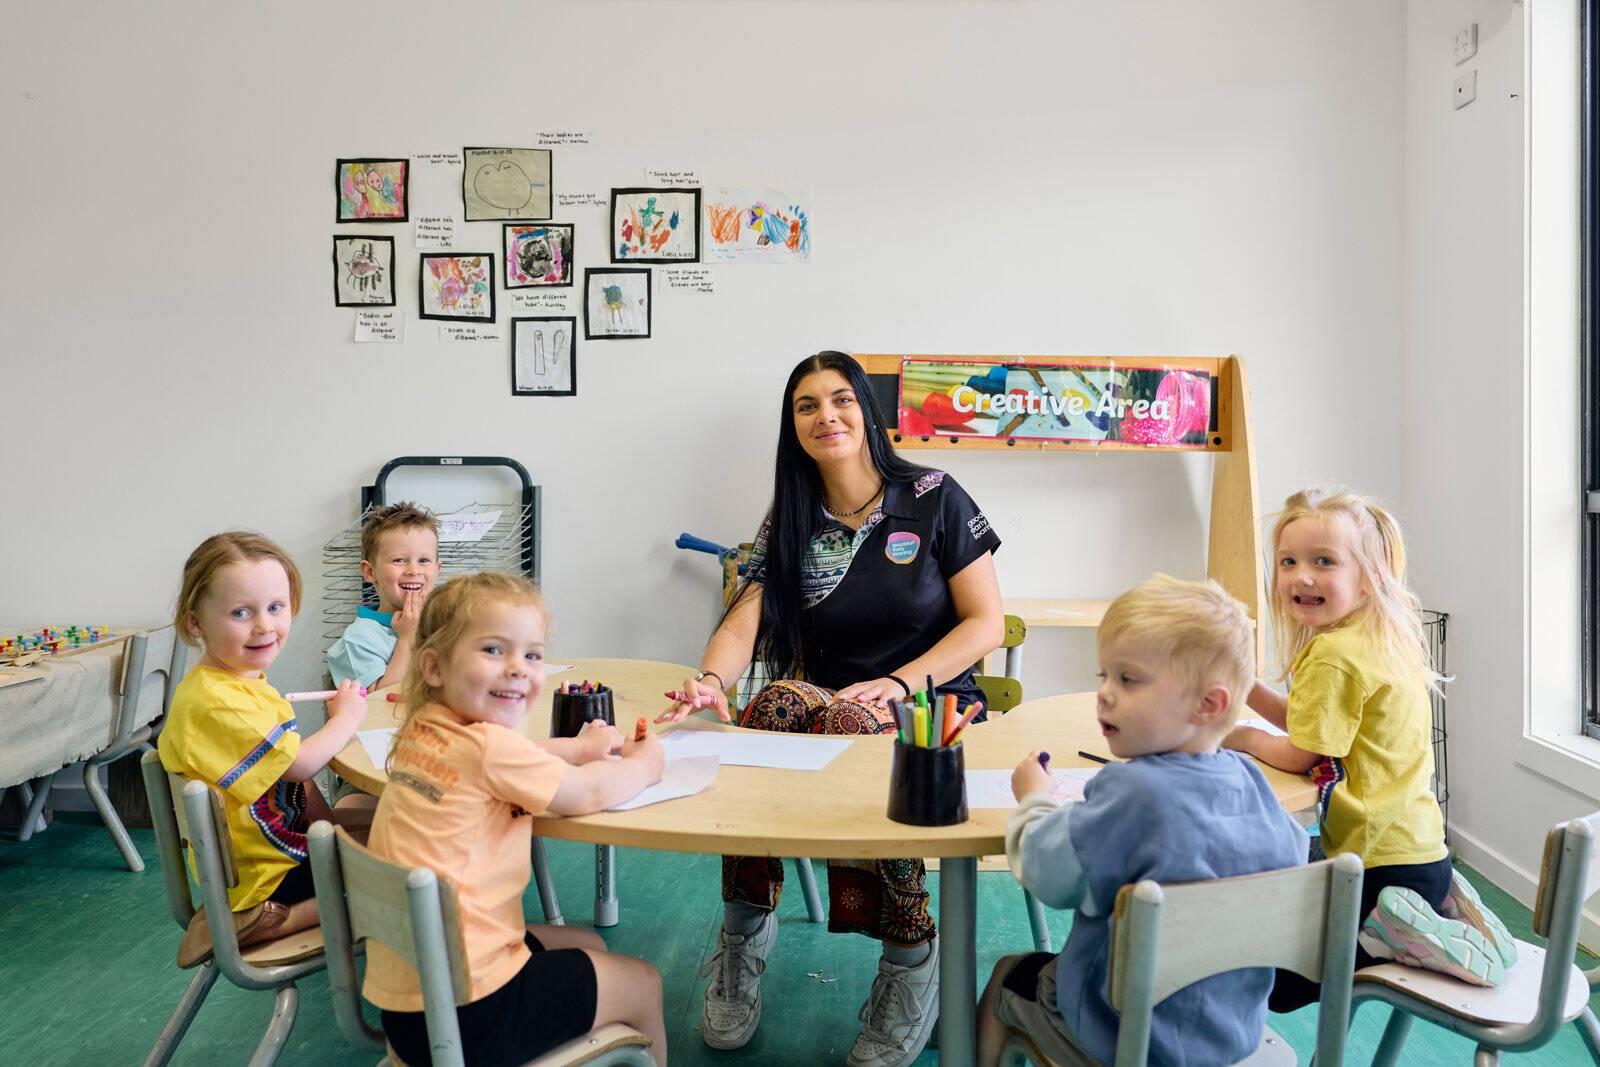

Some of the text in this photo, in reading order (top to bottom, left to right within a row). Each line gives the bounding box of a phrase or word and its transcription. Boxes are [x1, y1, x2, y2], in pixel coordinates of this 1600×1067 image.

[542, 292, 568, 300] different
[951, 386, 1171, 420] Creative Area
[970, 519, 989, 534] early
